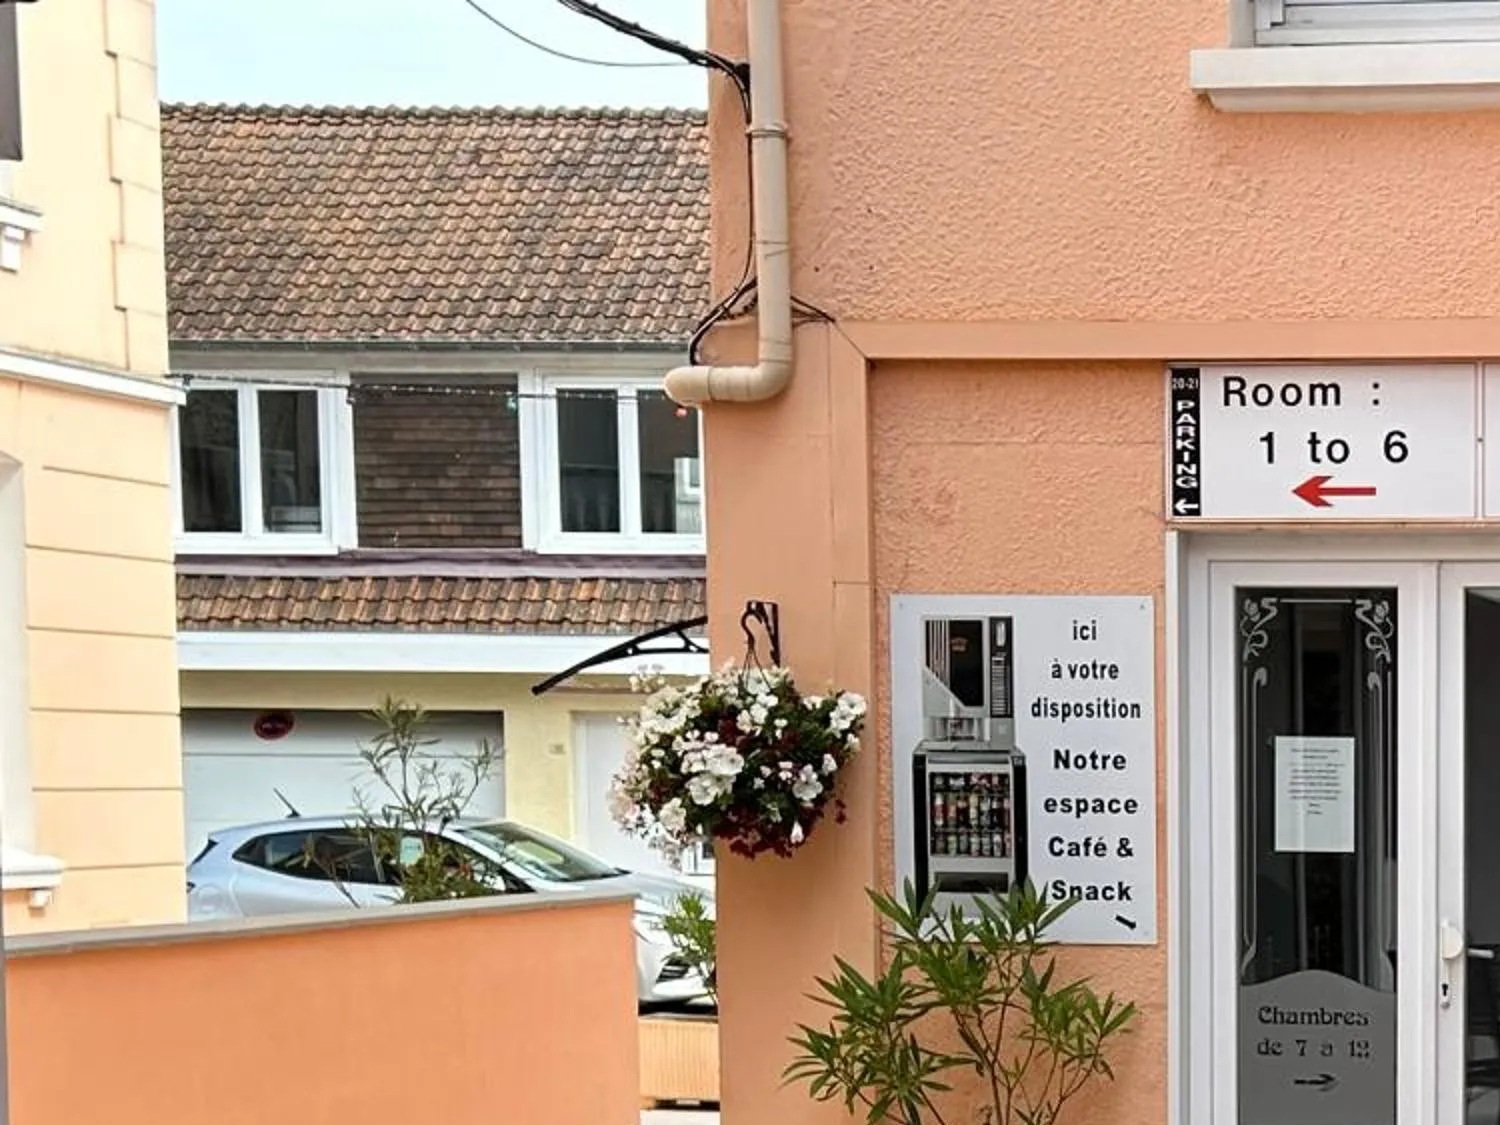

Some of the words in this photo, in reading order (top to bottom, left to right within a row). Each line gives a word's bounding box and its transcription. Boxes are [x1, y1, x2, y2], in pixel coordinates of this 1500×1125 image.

[1223, 376, 1341, 407] Room
[1175, 399, 1198, 489] PARKING
[1259, 432, 1274, 464] 1
[1307, 431, 1350, 464] to
[1383, 431, 1409, 464] 6
[1072, 619, 1097, 641] ici
[1051, 659, 1062, 680] à
[1067, 660, 1119, 680] votre
[1031, 698, 1141, 723] disposition
[1053, 749, 1127, 771] Notre
[1043, 797, 1138, 819] espace
[1048, 836, 1107, 858] Café
[1116, 836, 1134, 858] &
[1051, 879, 1132, 902] Snack
[1257, 1005, 1369, 1026] Chambres
[1257, 1038, 1283, 1056] de
[1295, 1039, 1307, 1057] 7
